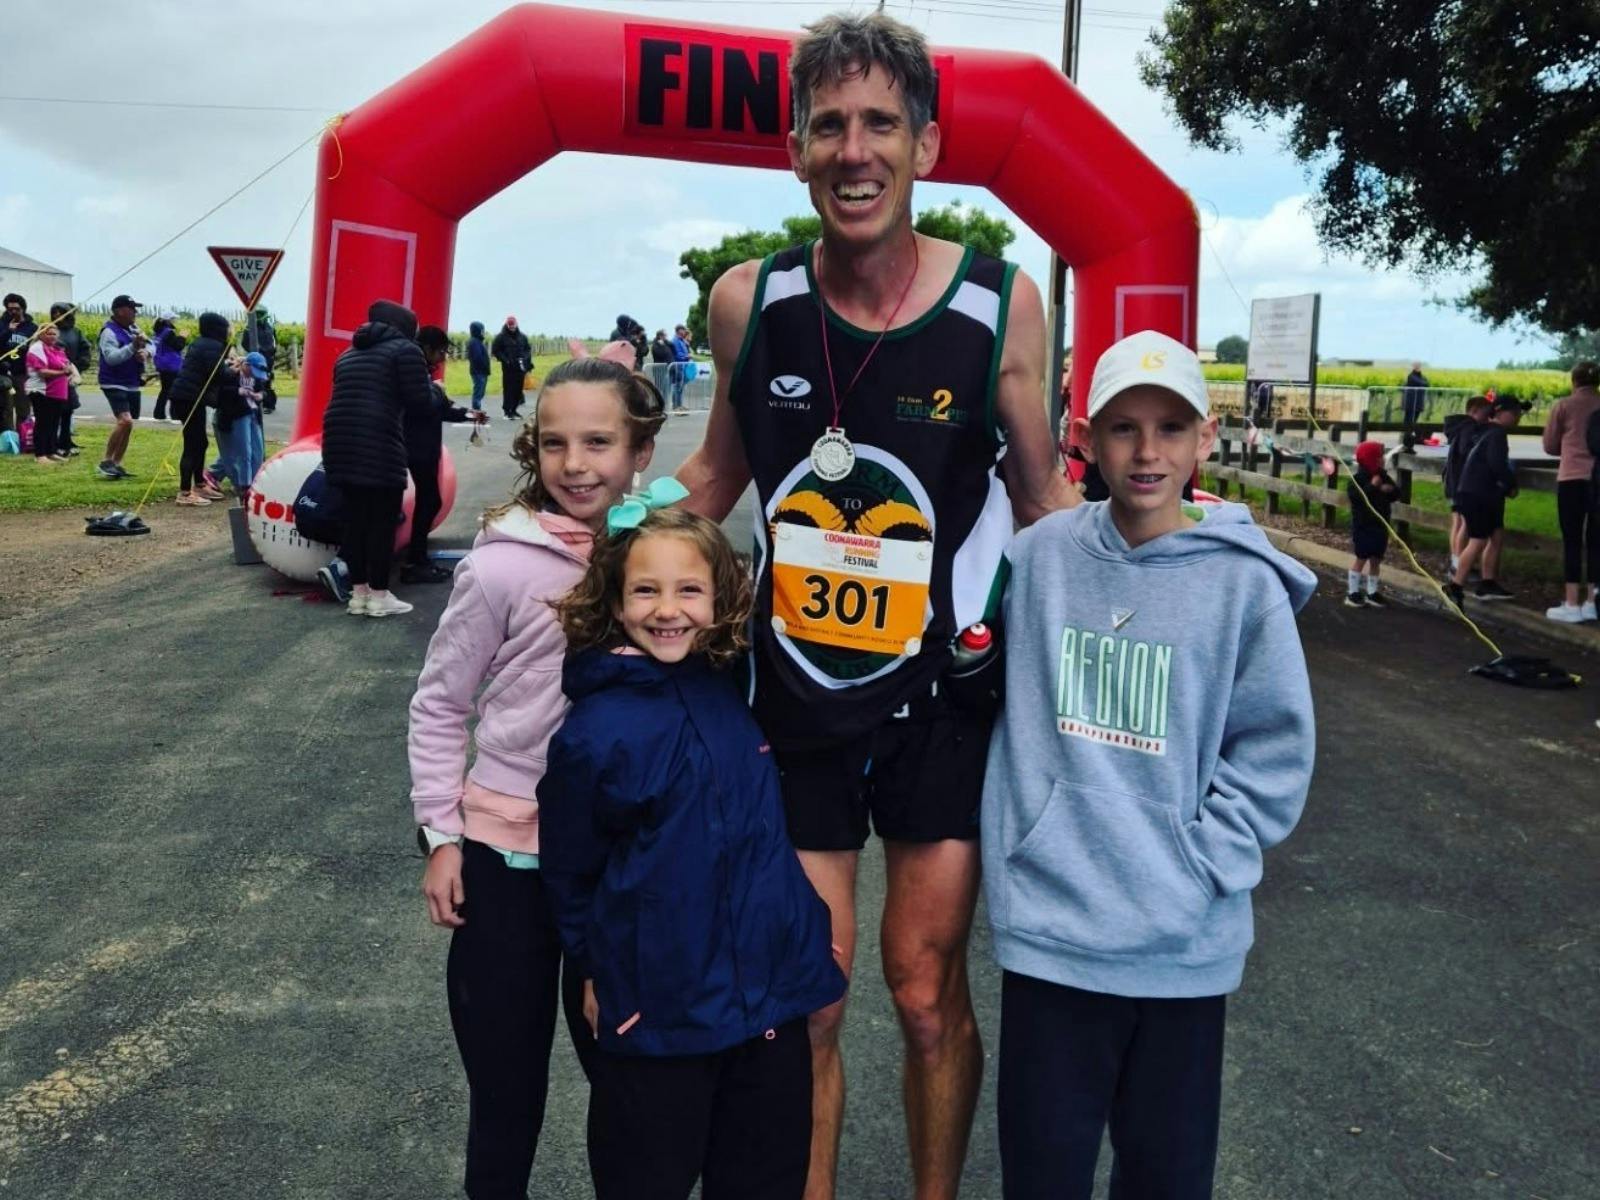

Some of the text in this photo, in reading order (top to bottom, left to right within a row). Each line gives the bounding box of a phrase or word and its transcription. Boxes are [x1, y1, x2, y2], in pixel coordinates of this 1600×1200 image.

[230, 258, 264, 271] GIVE
[237, 272, 259, 281] WAY
[930, 389, 953, 421] 2
[842, 497, 862, 511] TO
[843, 554, 879, 569] FESTIVAL
[800, 573, 890, 631] 301
[1056, 625, 1173, 738] REGION
